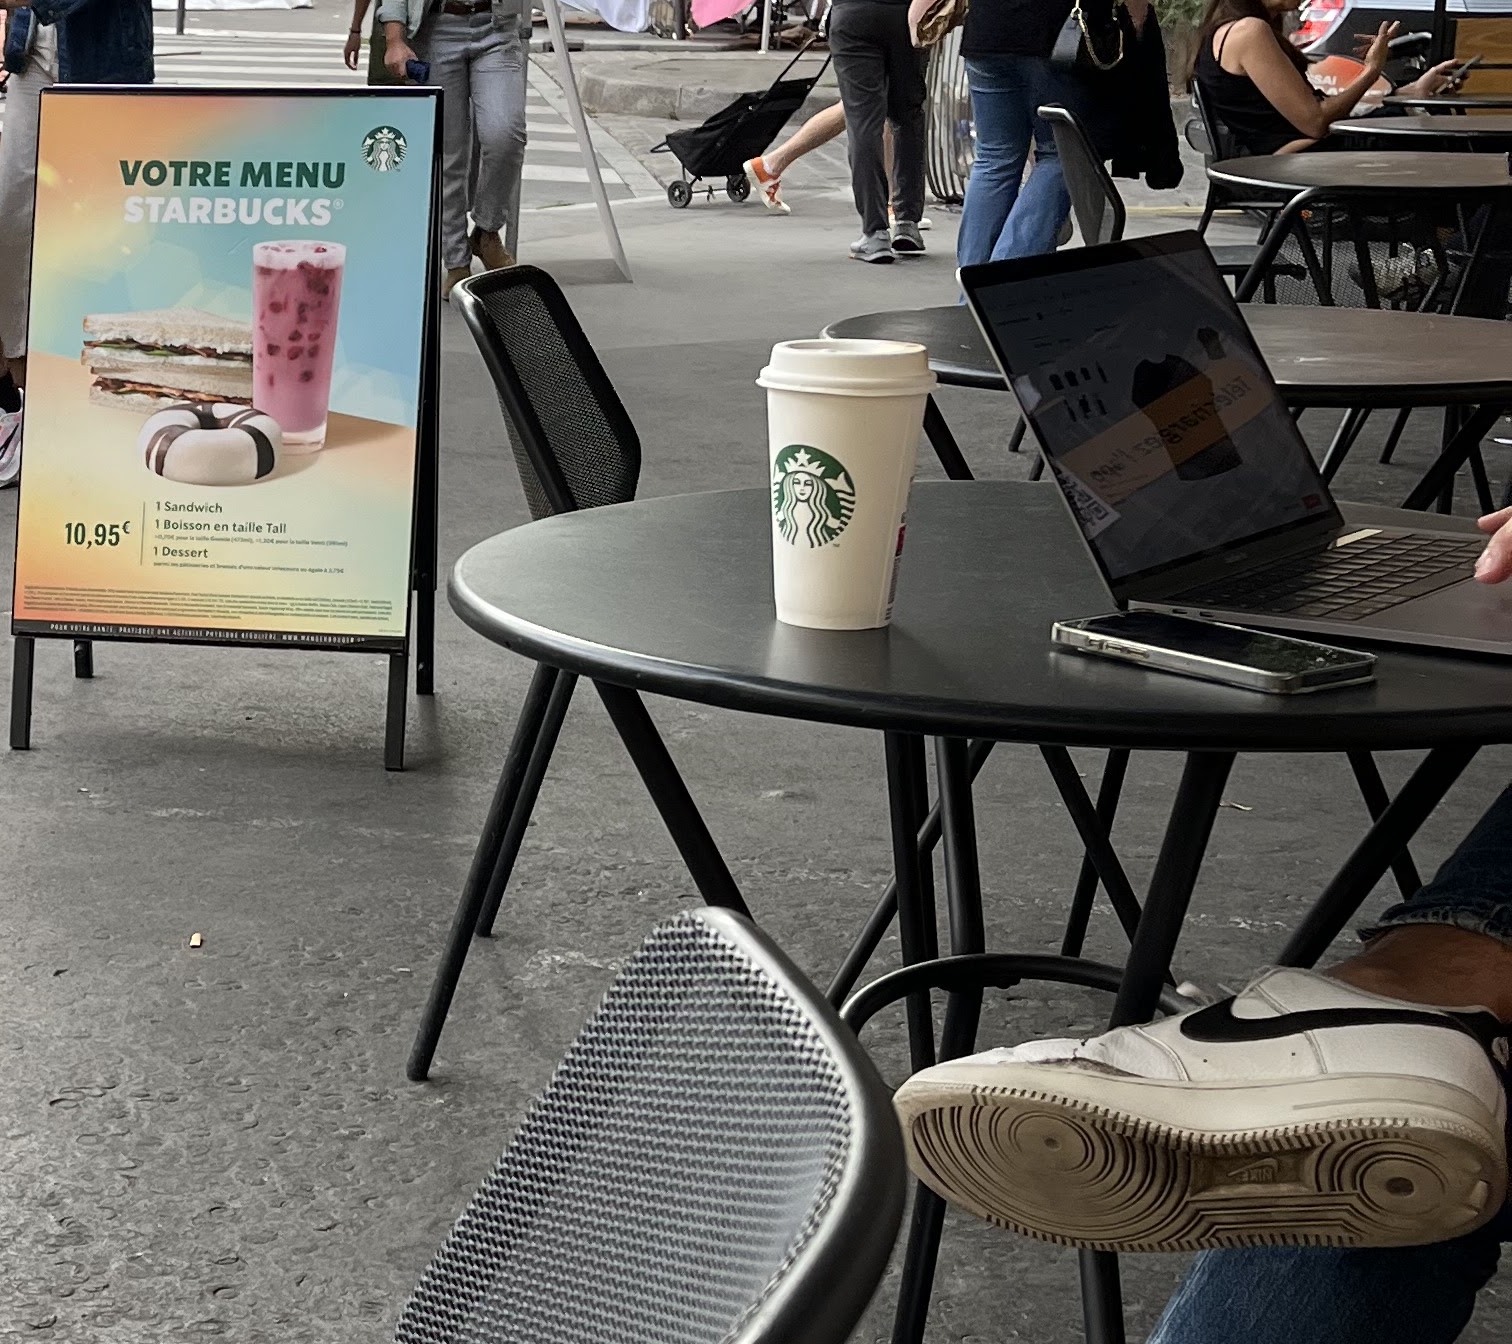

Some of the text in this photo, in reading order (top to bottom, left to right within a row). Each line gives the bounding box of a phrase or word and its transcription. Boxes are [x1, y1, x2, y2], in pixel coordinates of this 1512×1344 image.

[119, 159, 346, 189] VOTRE MENU
[155, 501, 223, 514] 1 Sandwich
[154, 518, 287, 534] 1 Boisson en taille Tall
[64, 520, 131, 549] 10,95€
[153, 546, 208, 559] 1 Dessert
